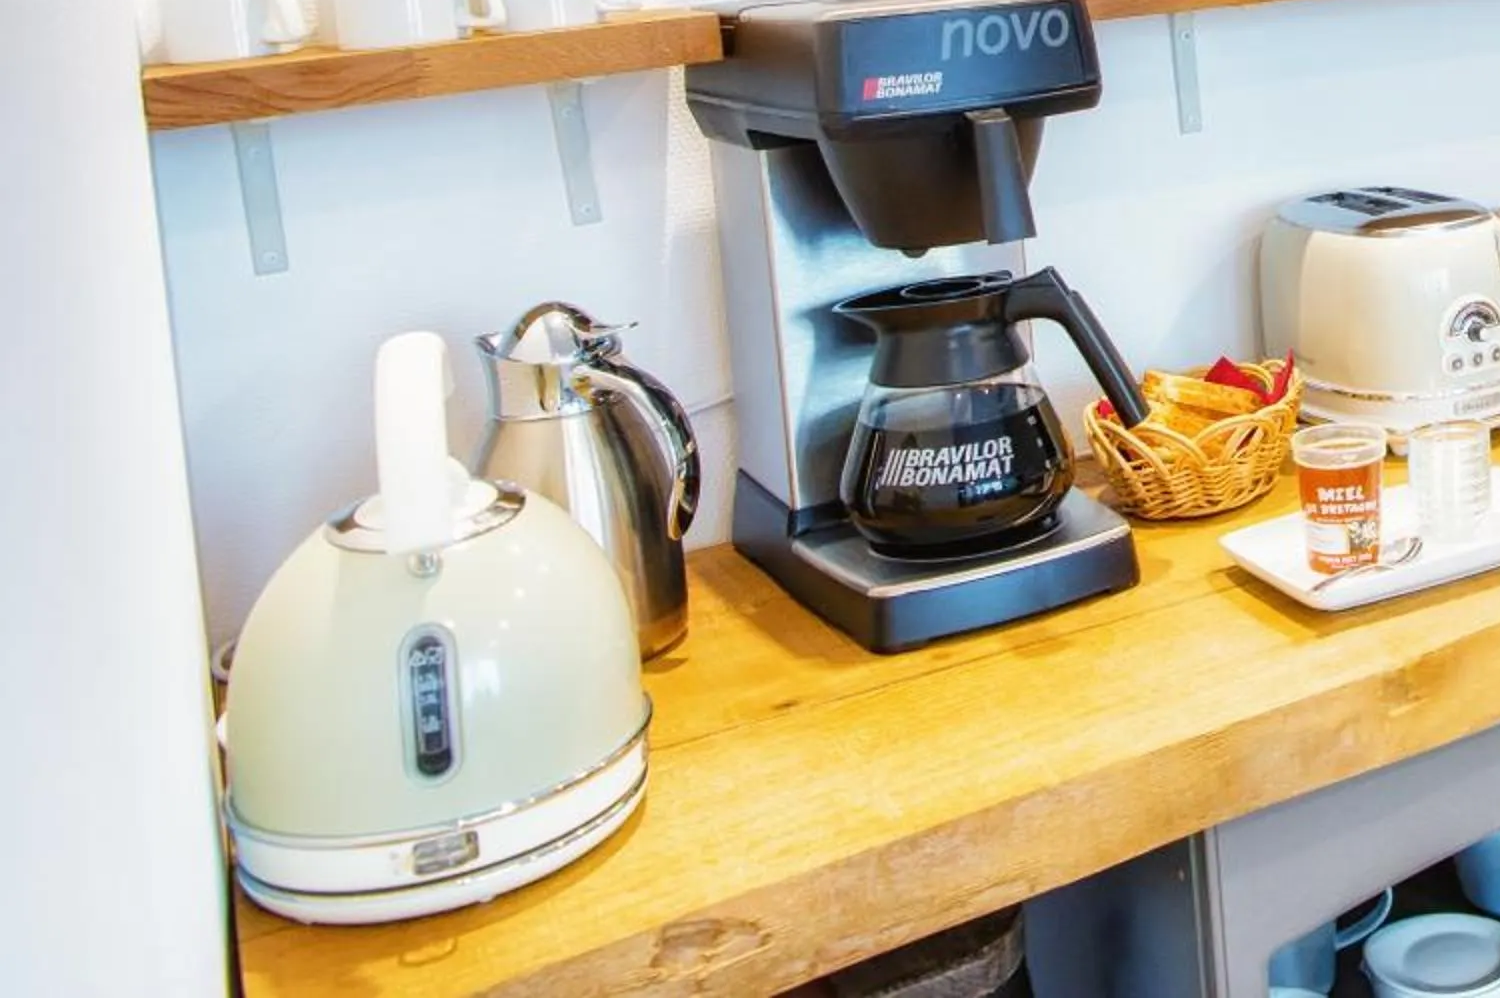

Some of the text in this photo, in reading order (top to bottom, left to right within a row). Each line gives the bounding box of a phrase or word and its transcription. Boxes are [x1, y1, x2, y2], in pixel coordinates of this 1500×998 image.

[941, 8, 1070, 60] novo
[876, 81, 942, 100] BONAMAT
[877, 71, 943, 88] BRAVILOR
[905, 435, 1013, 467] BRAVILOR
[900, 454, 1015, 487] BONAMAT
[1316, 485, 1365, 503] MIEL
